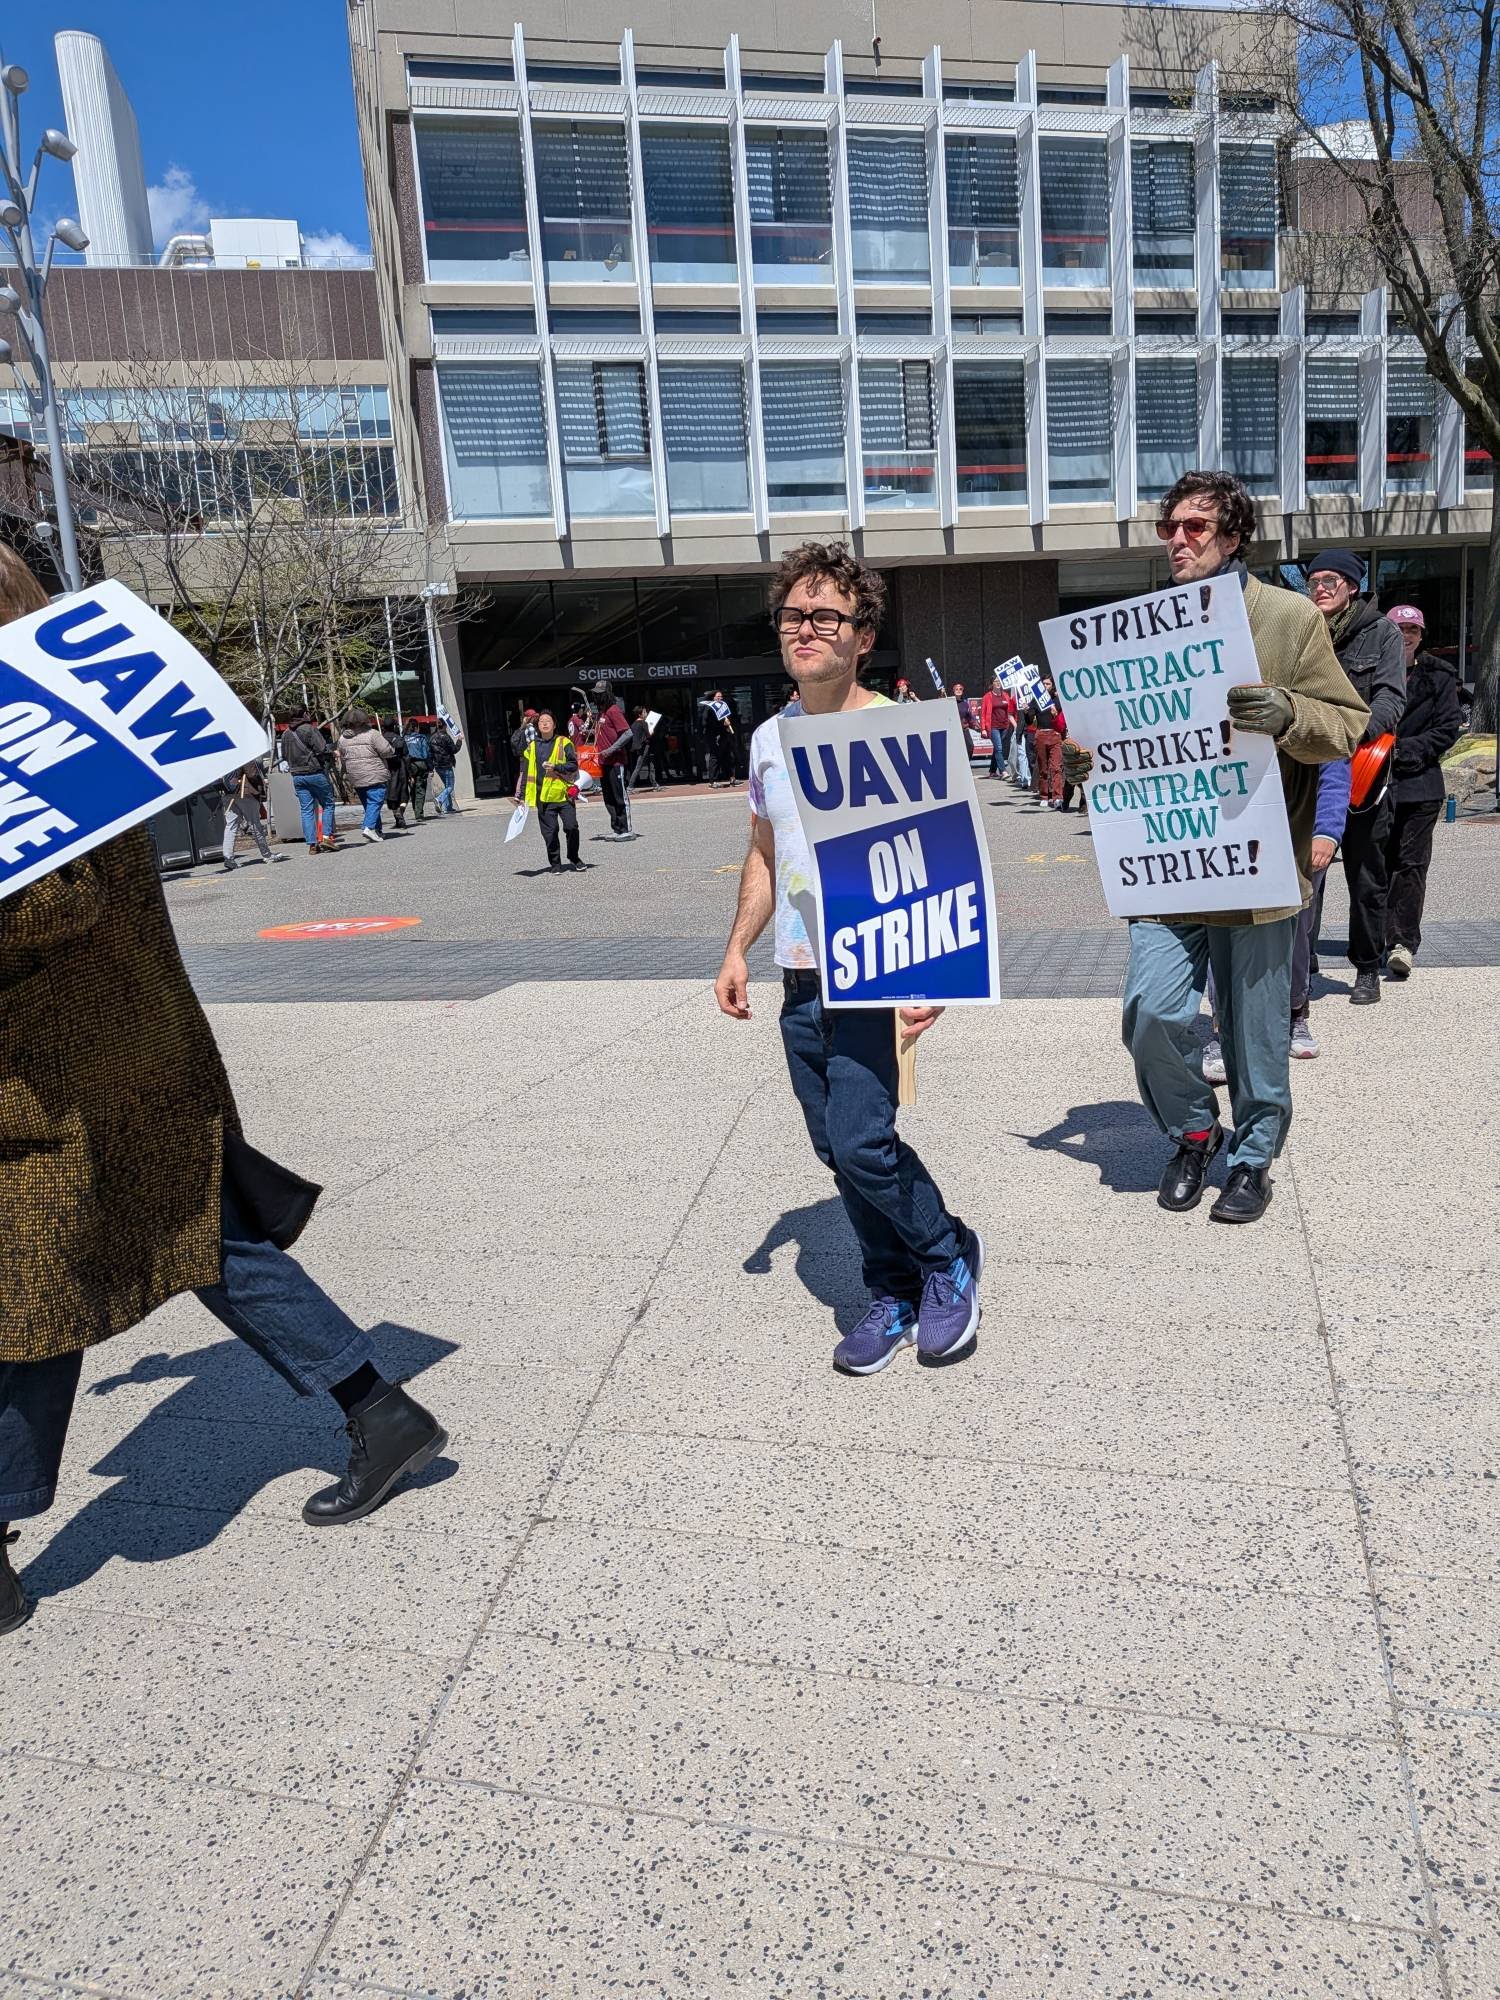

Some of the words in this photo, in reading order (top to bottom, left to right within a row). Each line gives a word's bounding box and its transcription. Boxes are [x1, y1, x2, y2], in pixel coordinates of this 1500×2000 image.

[1070, 585, 1212, 650] STRIKE!
[34, 600, 237, 766] UAW
[579, 667, 635, 680] SCIENCE
[647, 664, 698, 677] CENTER
[996, 658, 1018, 672] UAW
[1058, 638, 1225, 702] CONTRACT
[1114, 687, 1193, 731] NOW
[791, 730, 948, 811] UAW
[1097, 719, 1233, 773] STRIKE!
[1091, 761, 1249, 814] CONTRACT
[1142, 805, 1219, 845] NOW
[868, 828, 928, 904] ON
[1119, 839, 1260, 887] STRIKE!
[832, 881, 980, 990] STRIKE
